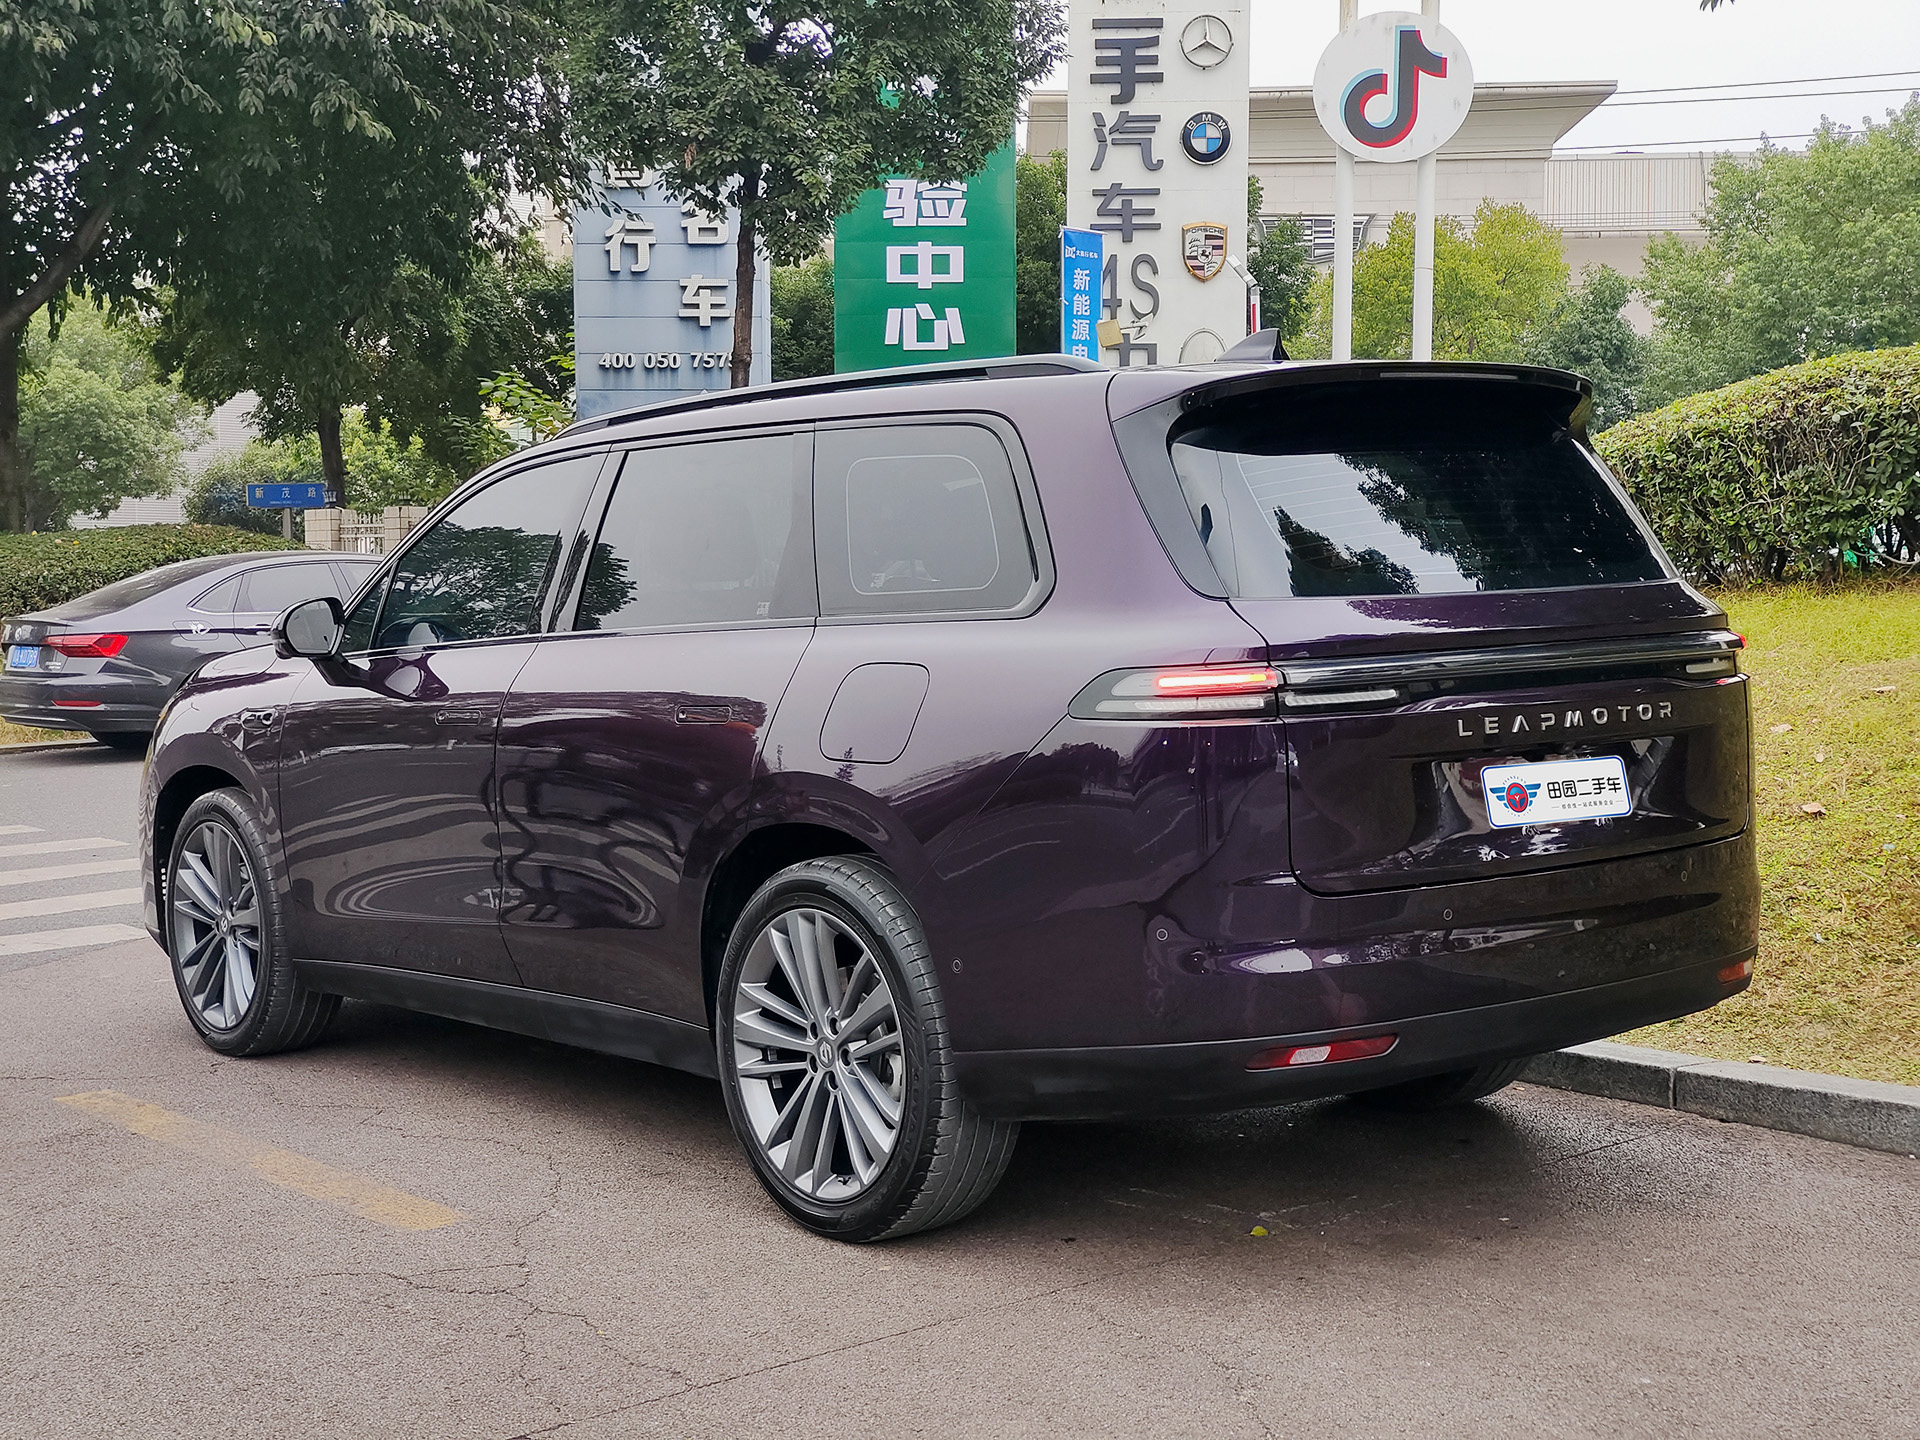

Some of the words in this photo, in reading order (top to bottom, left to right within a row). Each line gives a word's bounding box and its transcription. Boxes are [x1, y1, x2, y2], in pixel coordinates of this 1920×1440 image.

[1186, 113, 1228, 130] BMW
[1185, 227, 1225, 236] PORSCHE
[882, 179, 968, 351] 验中心
[598, 352, 637, 369] 400
[643, 352, 682, 369] 050
[1457, 701, 1673, 736] LEAPMOTOR
[1546, 776, 1622, 799] 田园二手车
